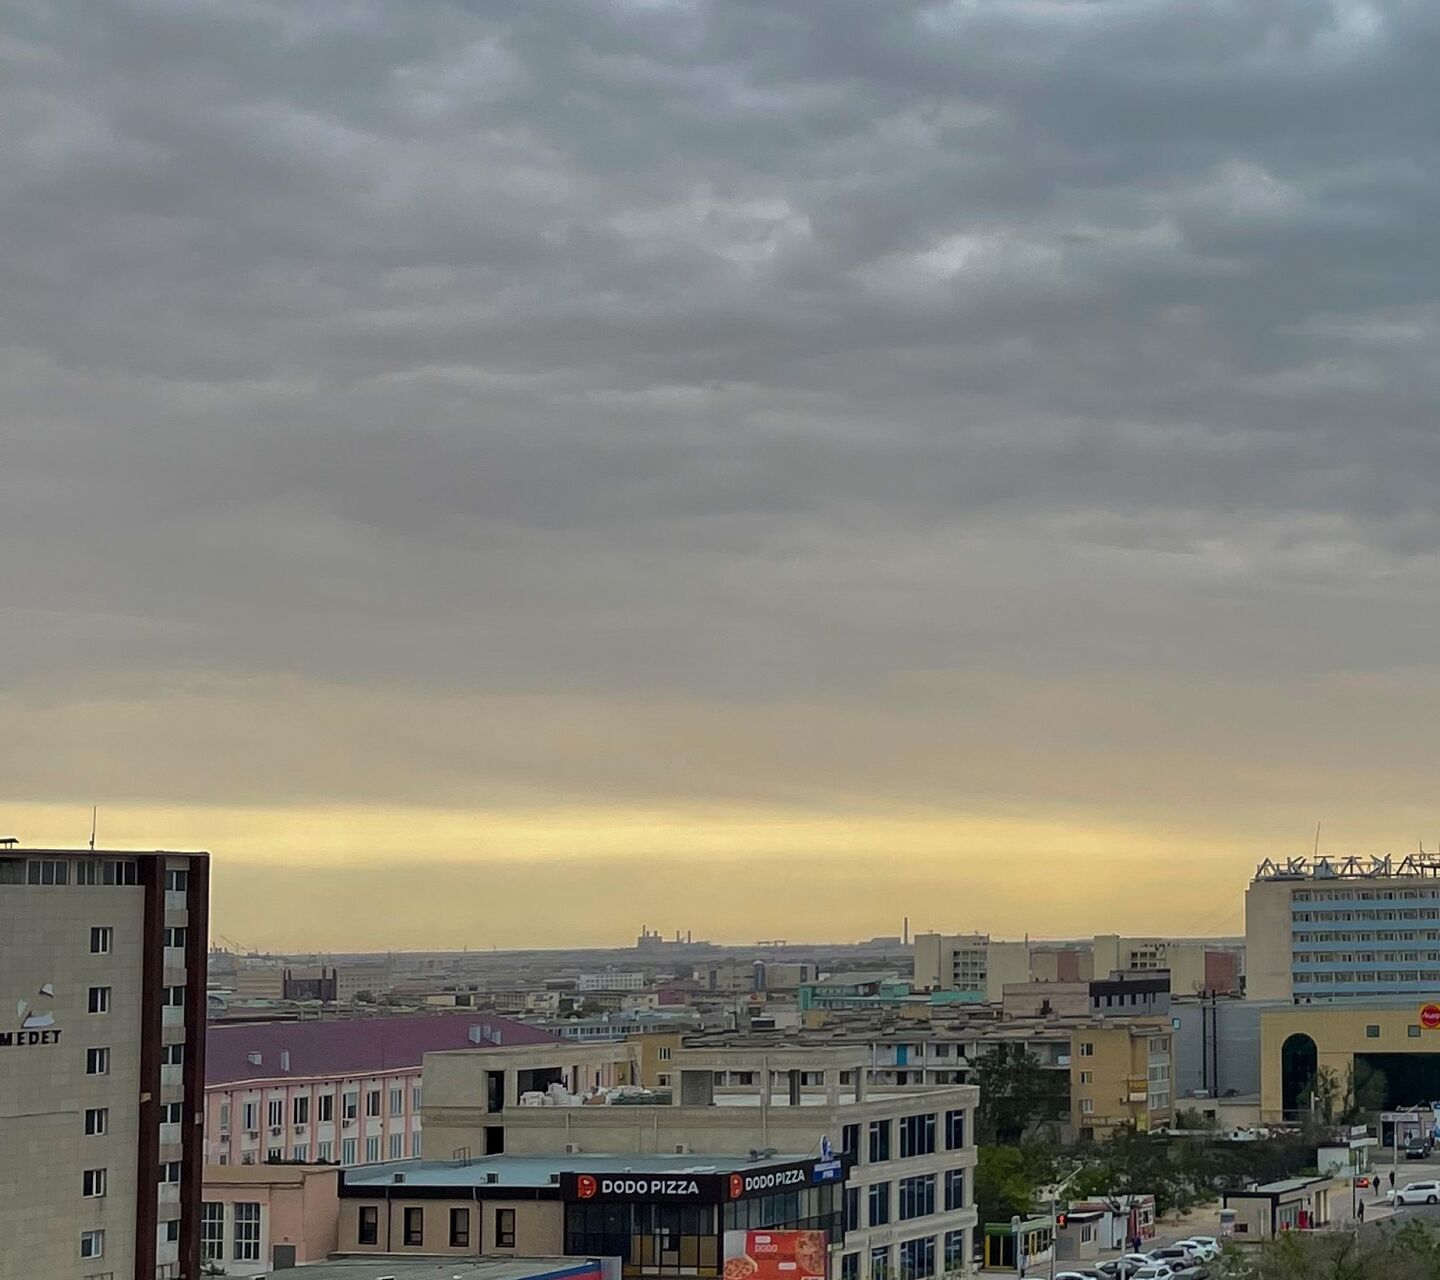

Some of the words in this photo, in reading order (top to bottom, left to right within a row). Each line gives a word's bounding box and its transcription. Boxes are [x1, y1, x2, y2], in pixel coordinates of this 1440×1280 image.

[602, 1180, 648, 1194] DODO
[650, 1180, 699, 1194] PIZZA
[745, 1174, 775, 1191] DODO
[775, 1169, 805, 1186] PIZZA
